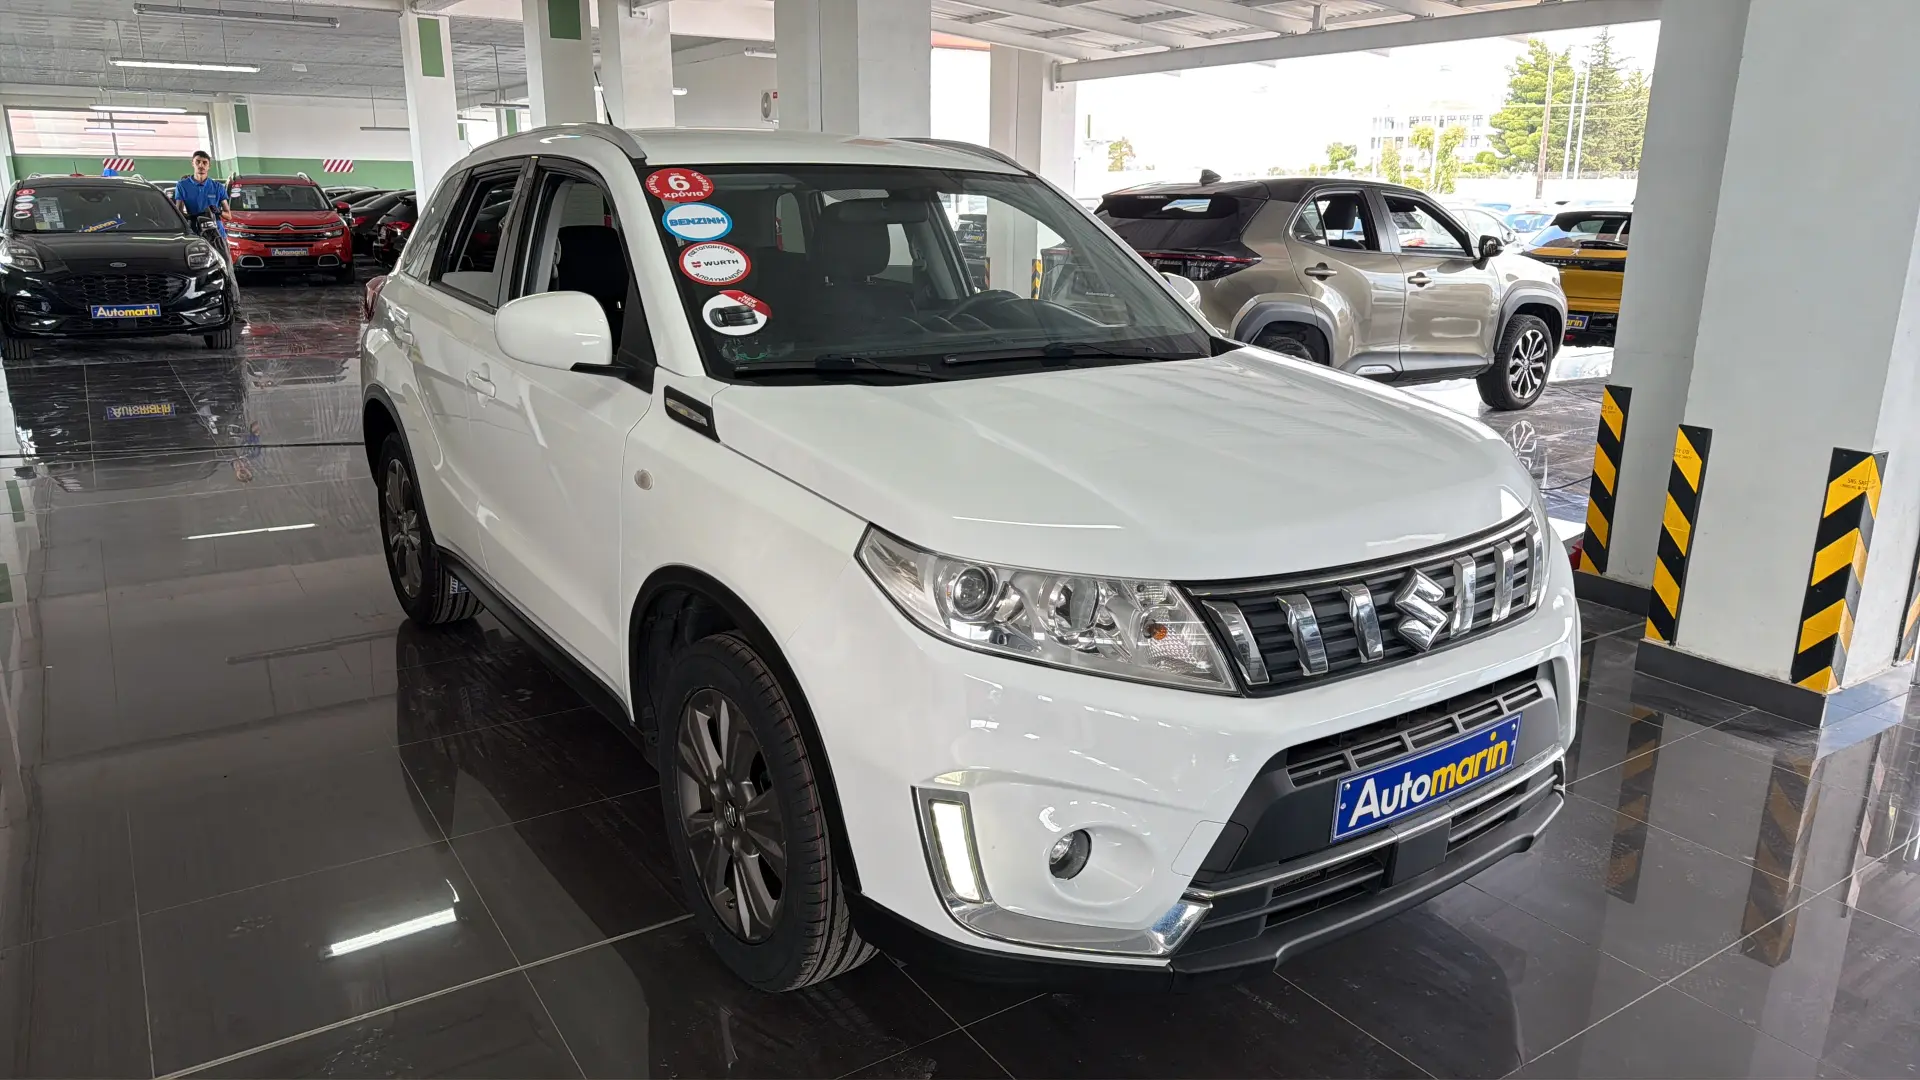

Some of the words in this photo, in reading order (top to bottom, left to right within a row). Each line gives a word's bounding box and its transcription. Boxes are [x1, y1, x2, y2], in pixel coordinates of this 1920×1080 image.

[668, 175, 690, 191] 6
[663, 190, 705, 199] χρόνια
[96, 305, 157, 317] Automarin
[1347, 731, 1508, 828] Automarin
